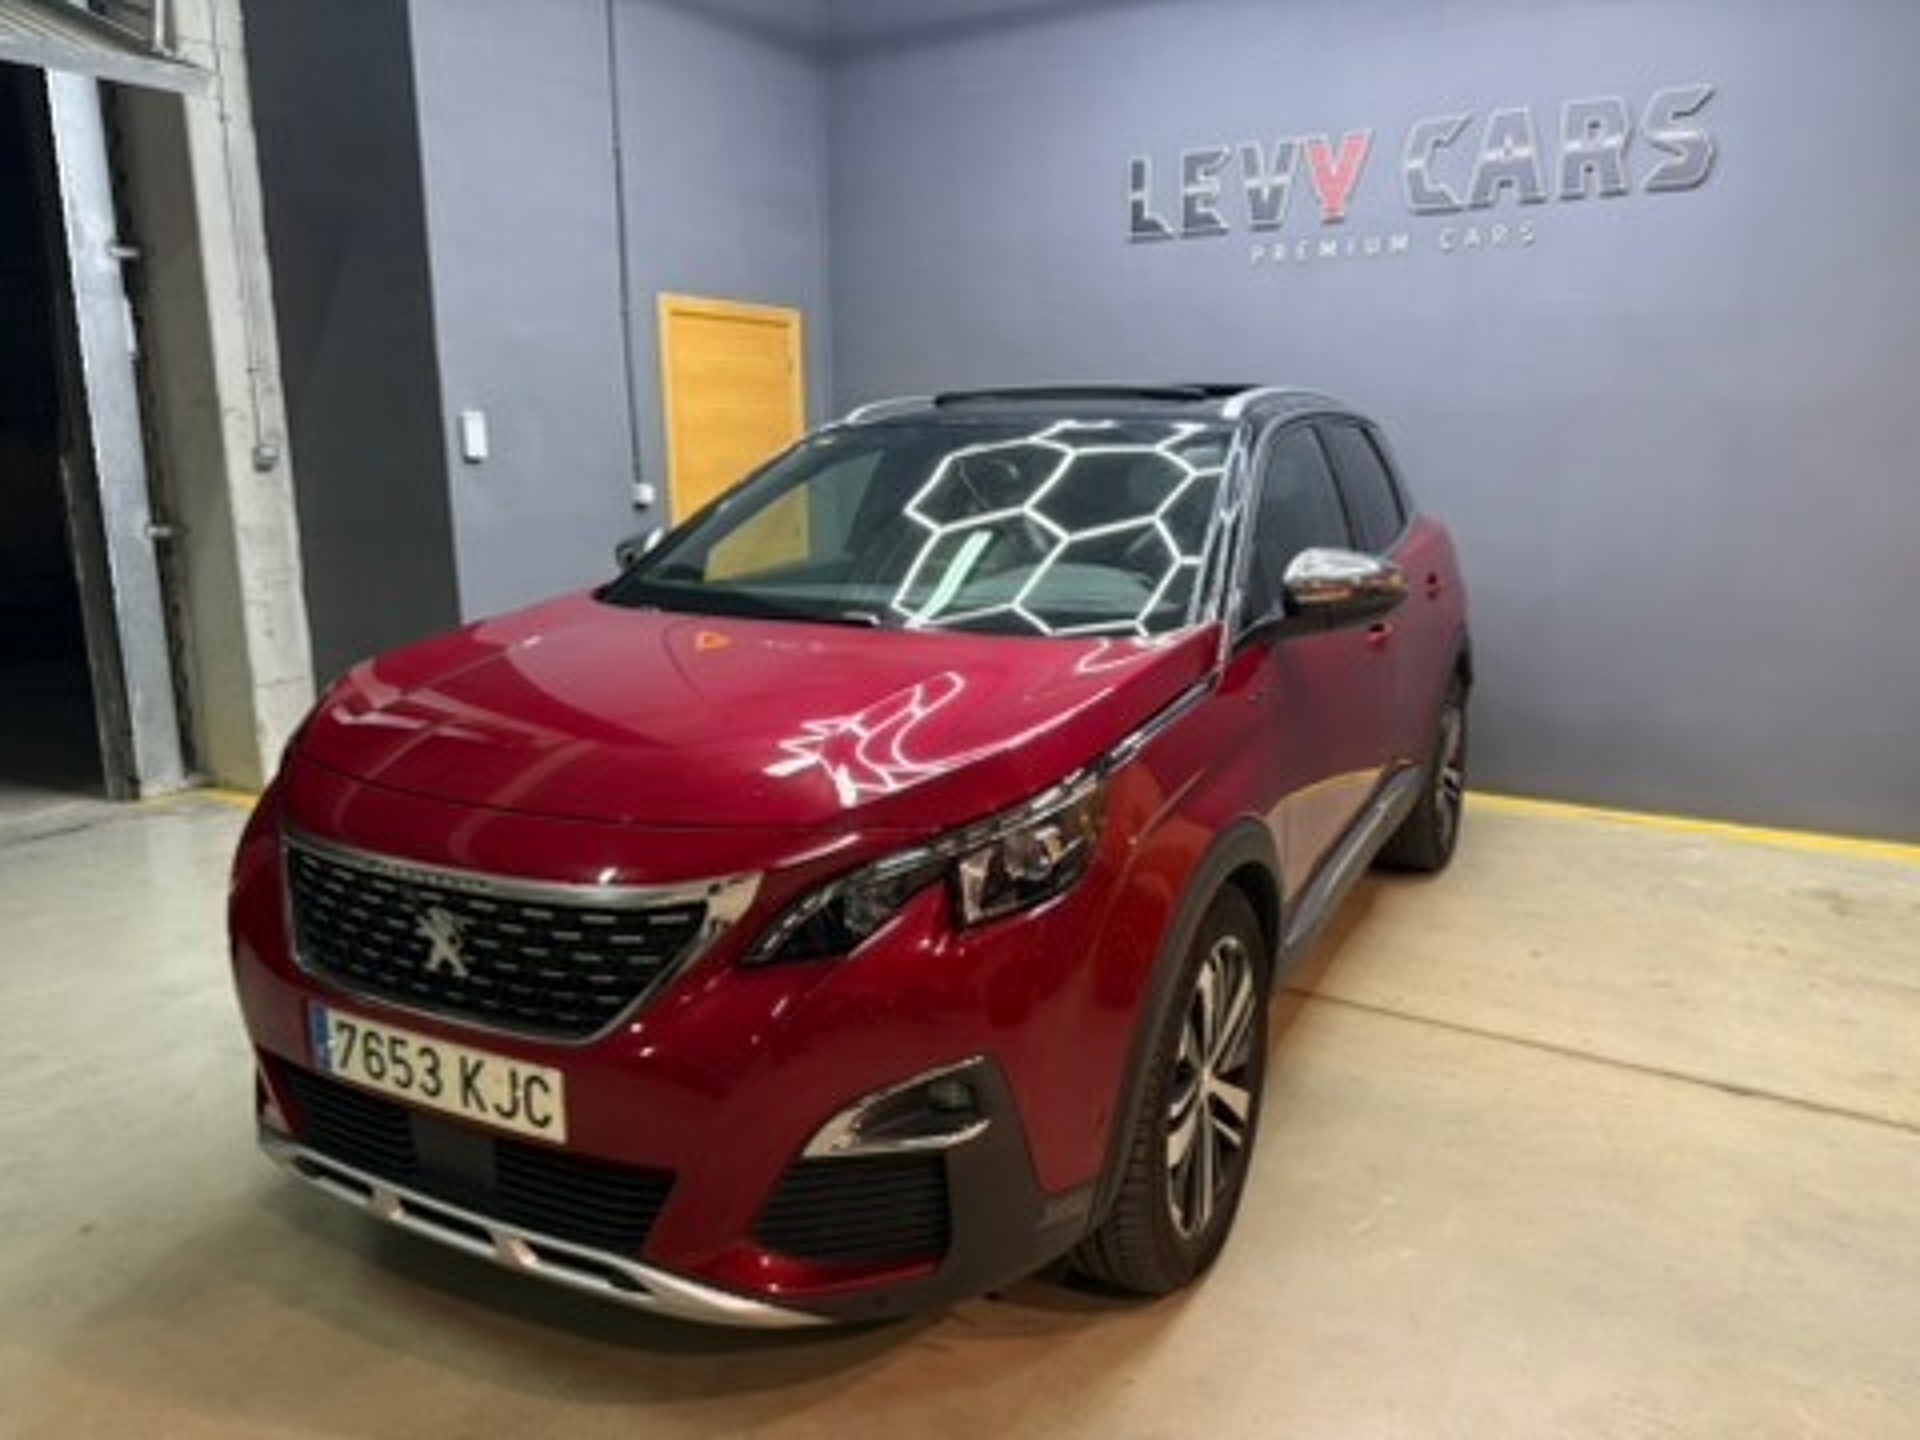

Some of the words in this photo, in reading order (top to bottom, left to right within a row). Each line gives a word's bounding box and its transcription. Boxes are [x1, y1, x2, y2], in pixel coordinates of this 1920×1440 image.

[1127, 127, 1373, 243] LEVY
[1403, 82, 1716, 215] CARS
[1250, 235, 1410, 264] PREMIUM
[1438, 225, 1537, 250] CARS
[335, 1019, 443, 1098] 7653
[459, 1054, 552, 1129] KJC
